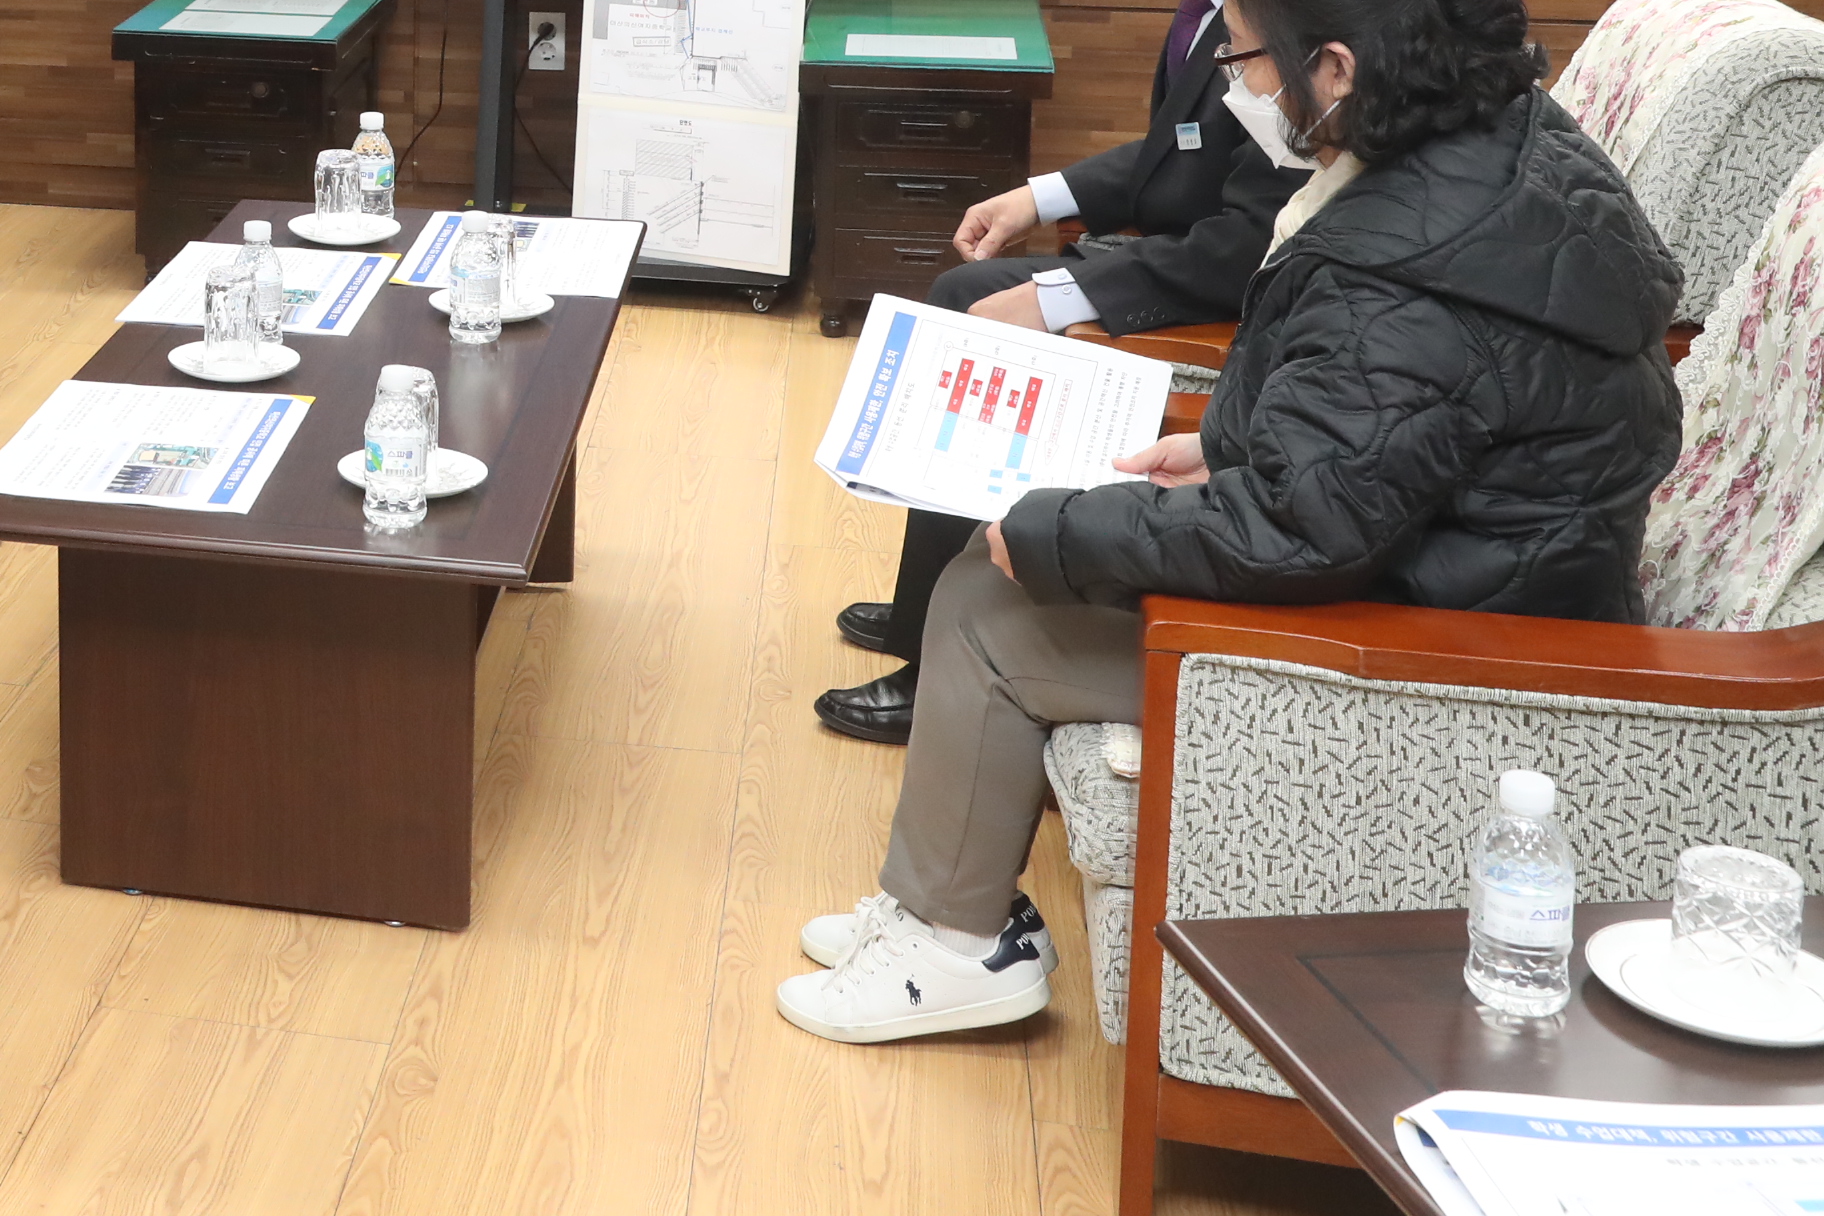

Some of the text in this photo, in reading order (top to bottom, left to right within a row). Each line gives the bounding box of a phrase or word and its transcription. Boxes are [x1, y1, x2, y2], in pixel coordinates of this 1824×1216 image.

[885, 350, 899, 366] 조치
[878, 368, 892, 382] 확보
[873, 383, 888, 397] 안전
[387, 449, 413, 460] 스파클
